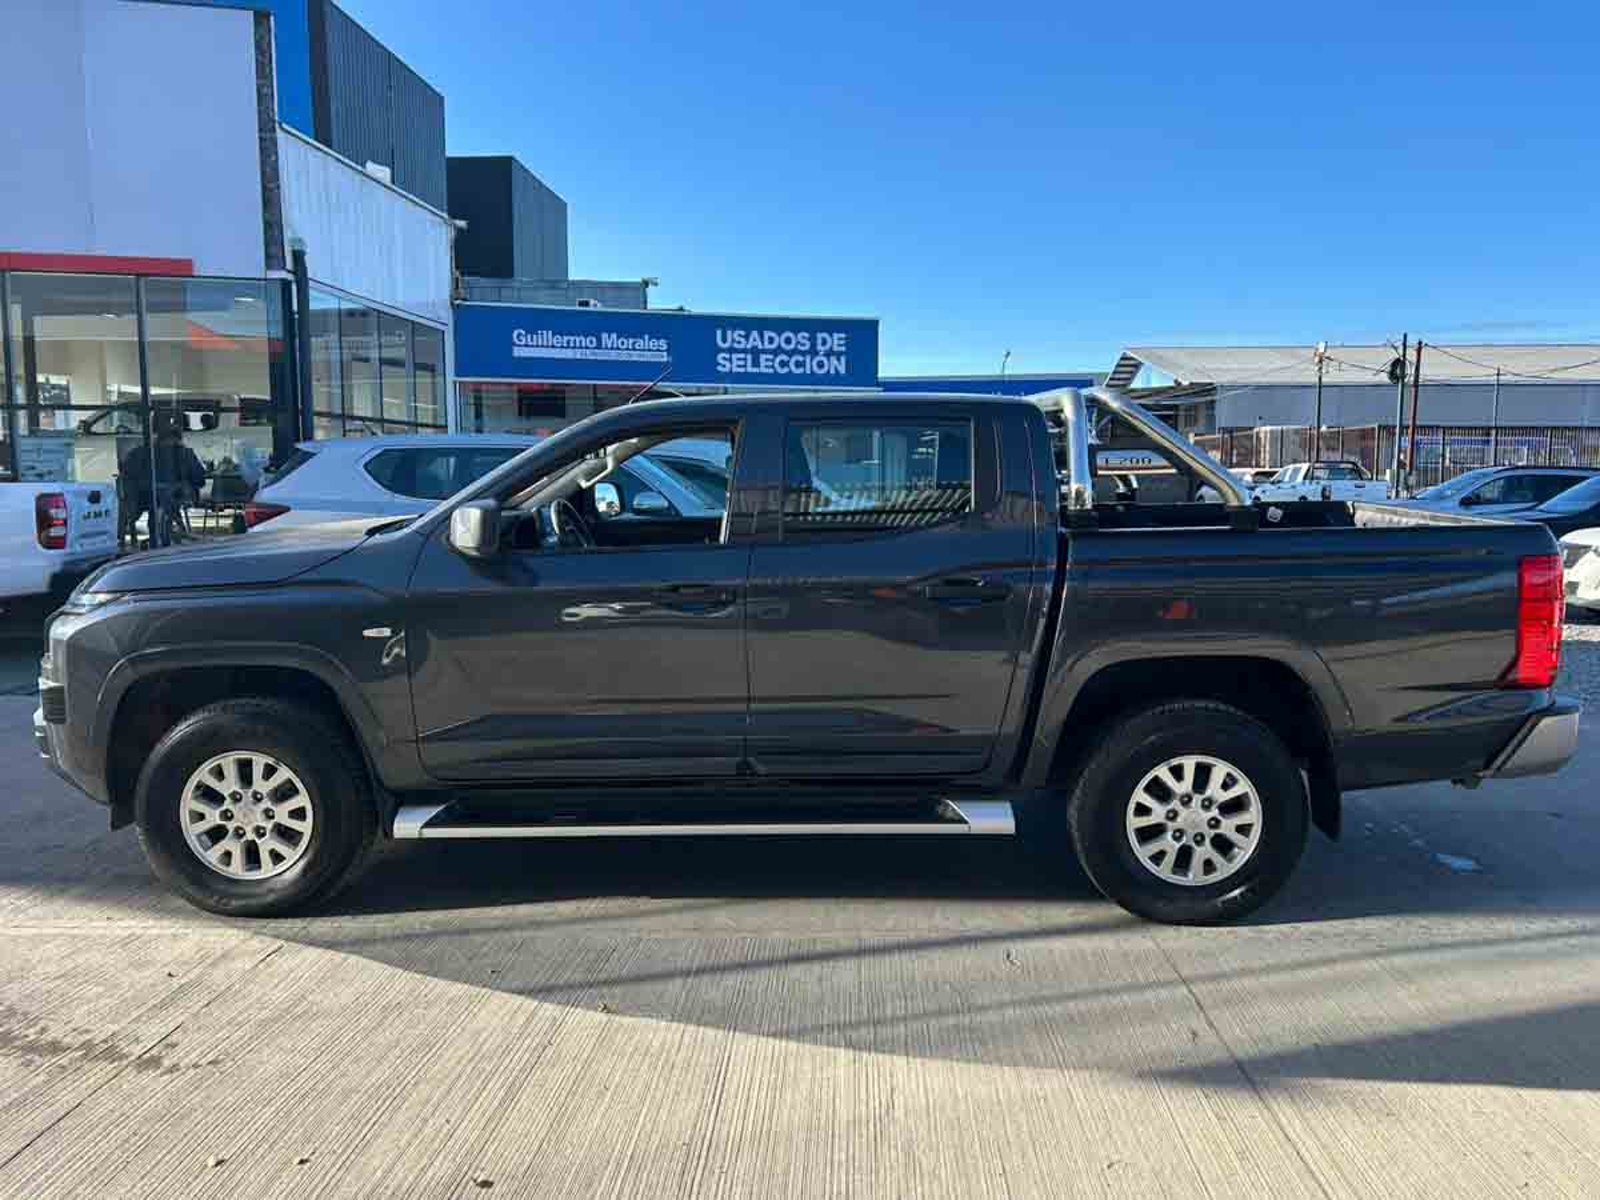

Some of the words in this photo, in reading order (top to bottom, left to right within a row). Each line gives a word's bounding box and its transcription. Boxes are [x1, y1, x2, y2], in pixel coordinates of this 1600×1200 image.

[512, 329, 597, 348] Guillermo
[601, 332, 668, 351] Morales
[716, 329, 811, 351] USADOS
[816, 332, 847, 352] DE
[716, 351, 847, 374] SELECCIÓN
